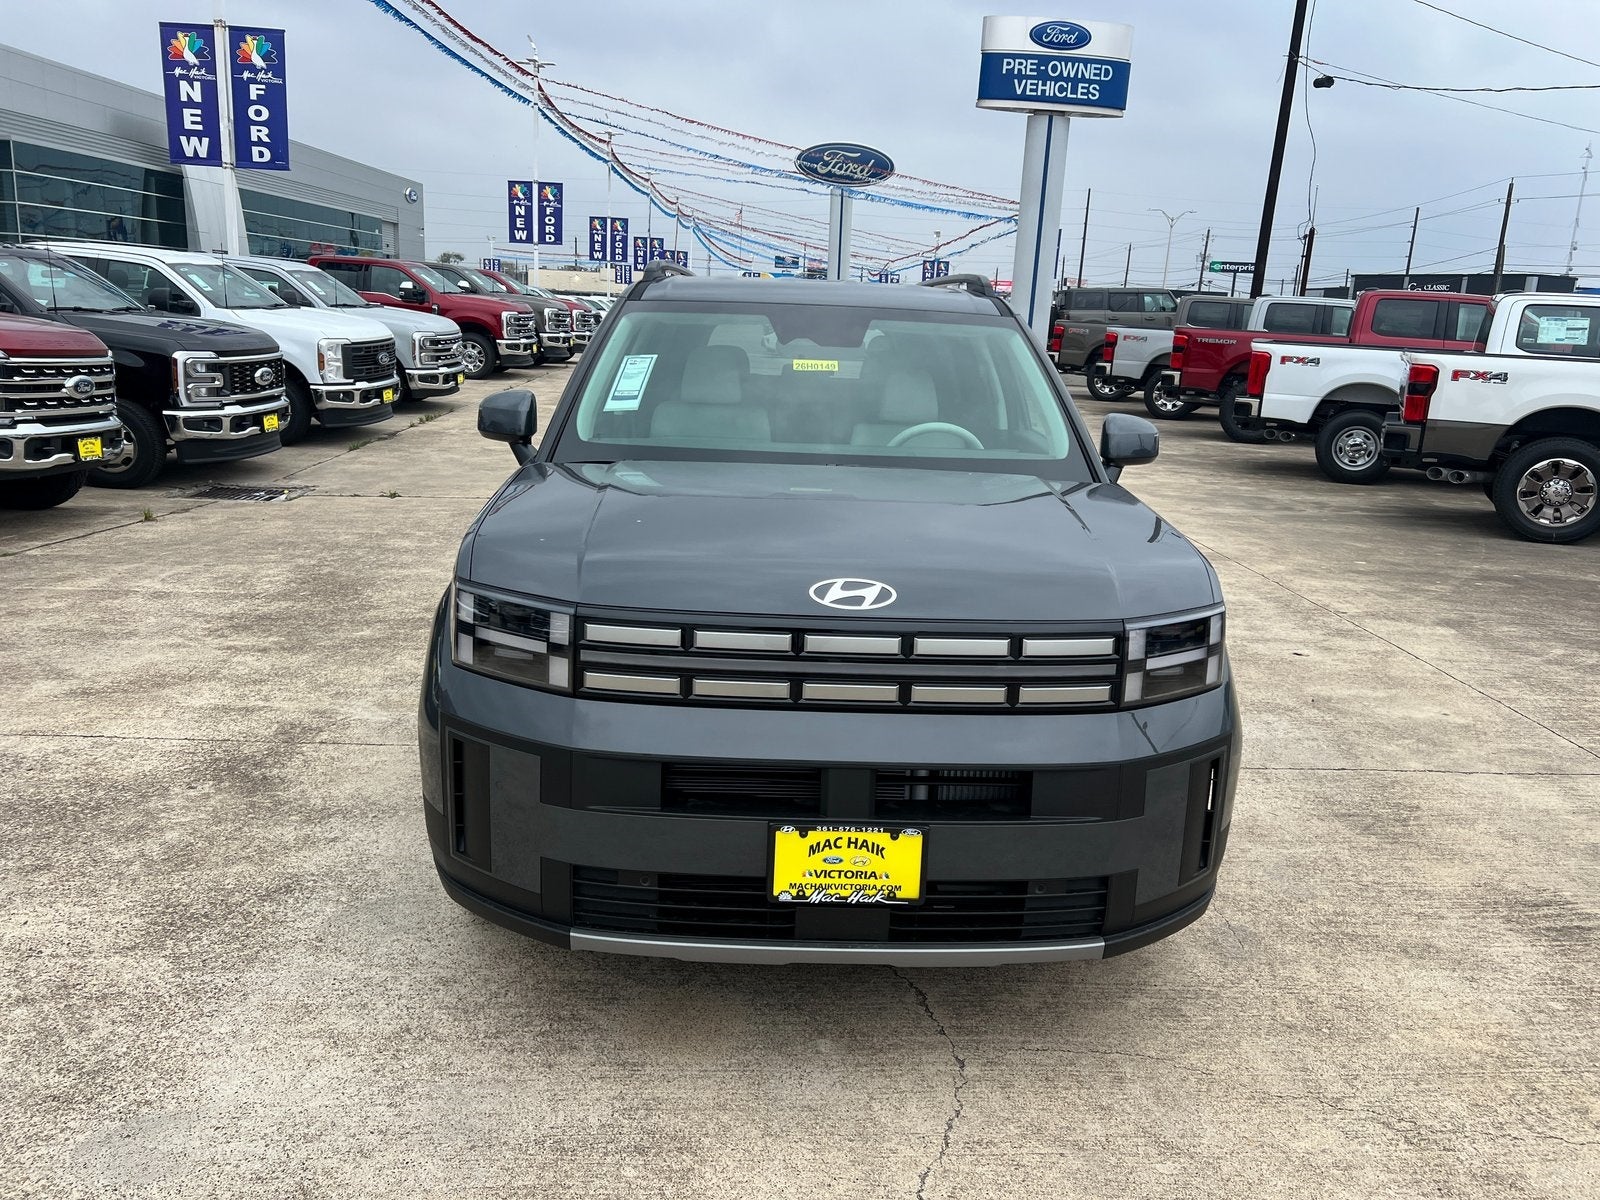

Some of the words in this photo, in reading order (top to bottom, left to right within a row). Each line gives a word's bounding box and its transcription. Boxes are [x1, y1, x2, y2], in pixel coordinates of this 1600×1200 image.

[1042, 25, 1079, 44] Ford
[1014, 79, 1100, 100] VEHICLES
[179, 80, 209, 158] NEW
[247, 84, 271, 163] FORD
[816, 149, 875, 177] Ford
[514, 205, 527, 241] NEW
[544, 207, 556, 243] FORD
[593, 234, 603, 260] NEW
[615, 235, 623, 261] FORD
[636, 250, 645, 270] NEW
[1211, 262, 1255, 272] enterpris
[1196, 337, 1237, 345] TREMOR
[1280, 355, 1321, 365] FX4
[1450, 368, 1509, 382] FX4
[808, 836, 843, 857] MAC
[847, 836, 886, 860] HAIK
[813, 869, 878, 880] VICTORIA
[788, 882, 902, 892] MACHAIKVICTORIA.COM
[807, 888, 843, 904] Mac
[846, 889, 889, 904] Haik
